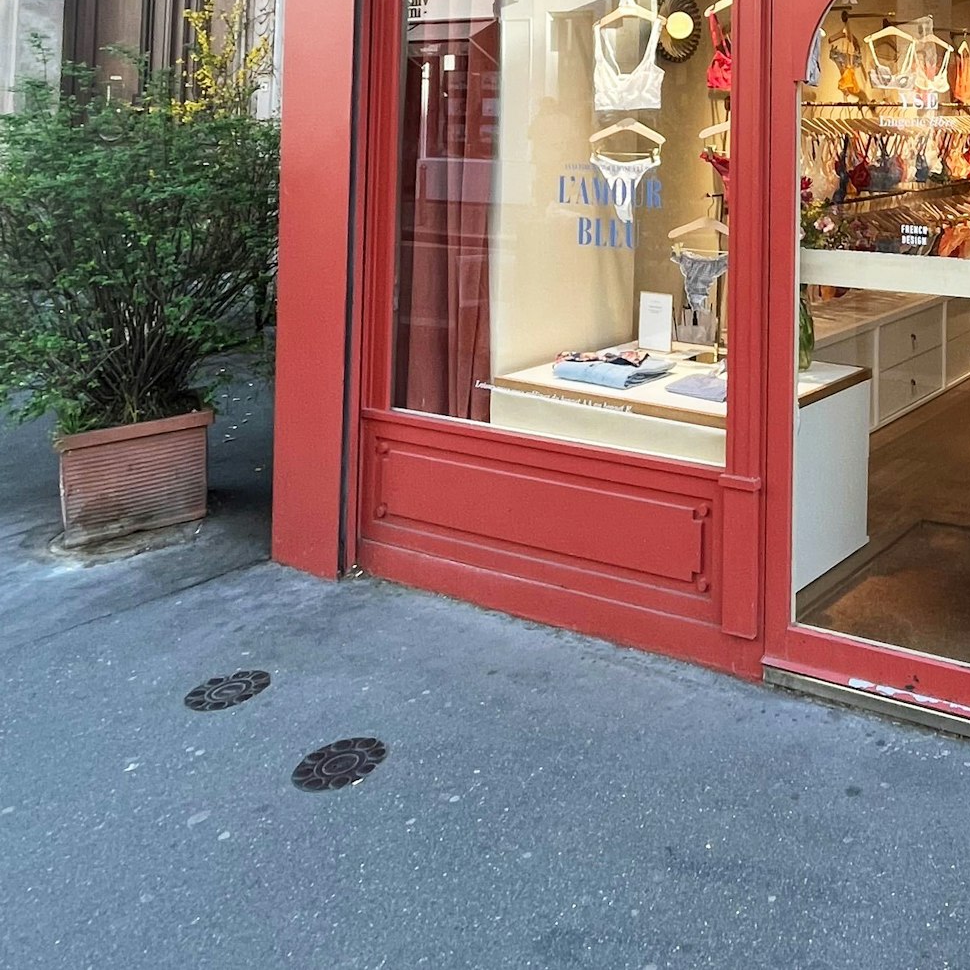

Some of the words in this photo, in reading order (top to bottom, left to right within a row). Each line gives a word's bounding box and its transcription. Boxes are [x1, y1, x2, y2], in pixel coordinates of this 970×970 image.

[559, 176, 663, 209] L'AMOUR
[900, 224, 928, 235] FRENCH
[901, 235, 927, 246] DESIGN
